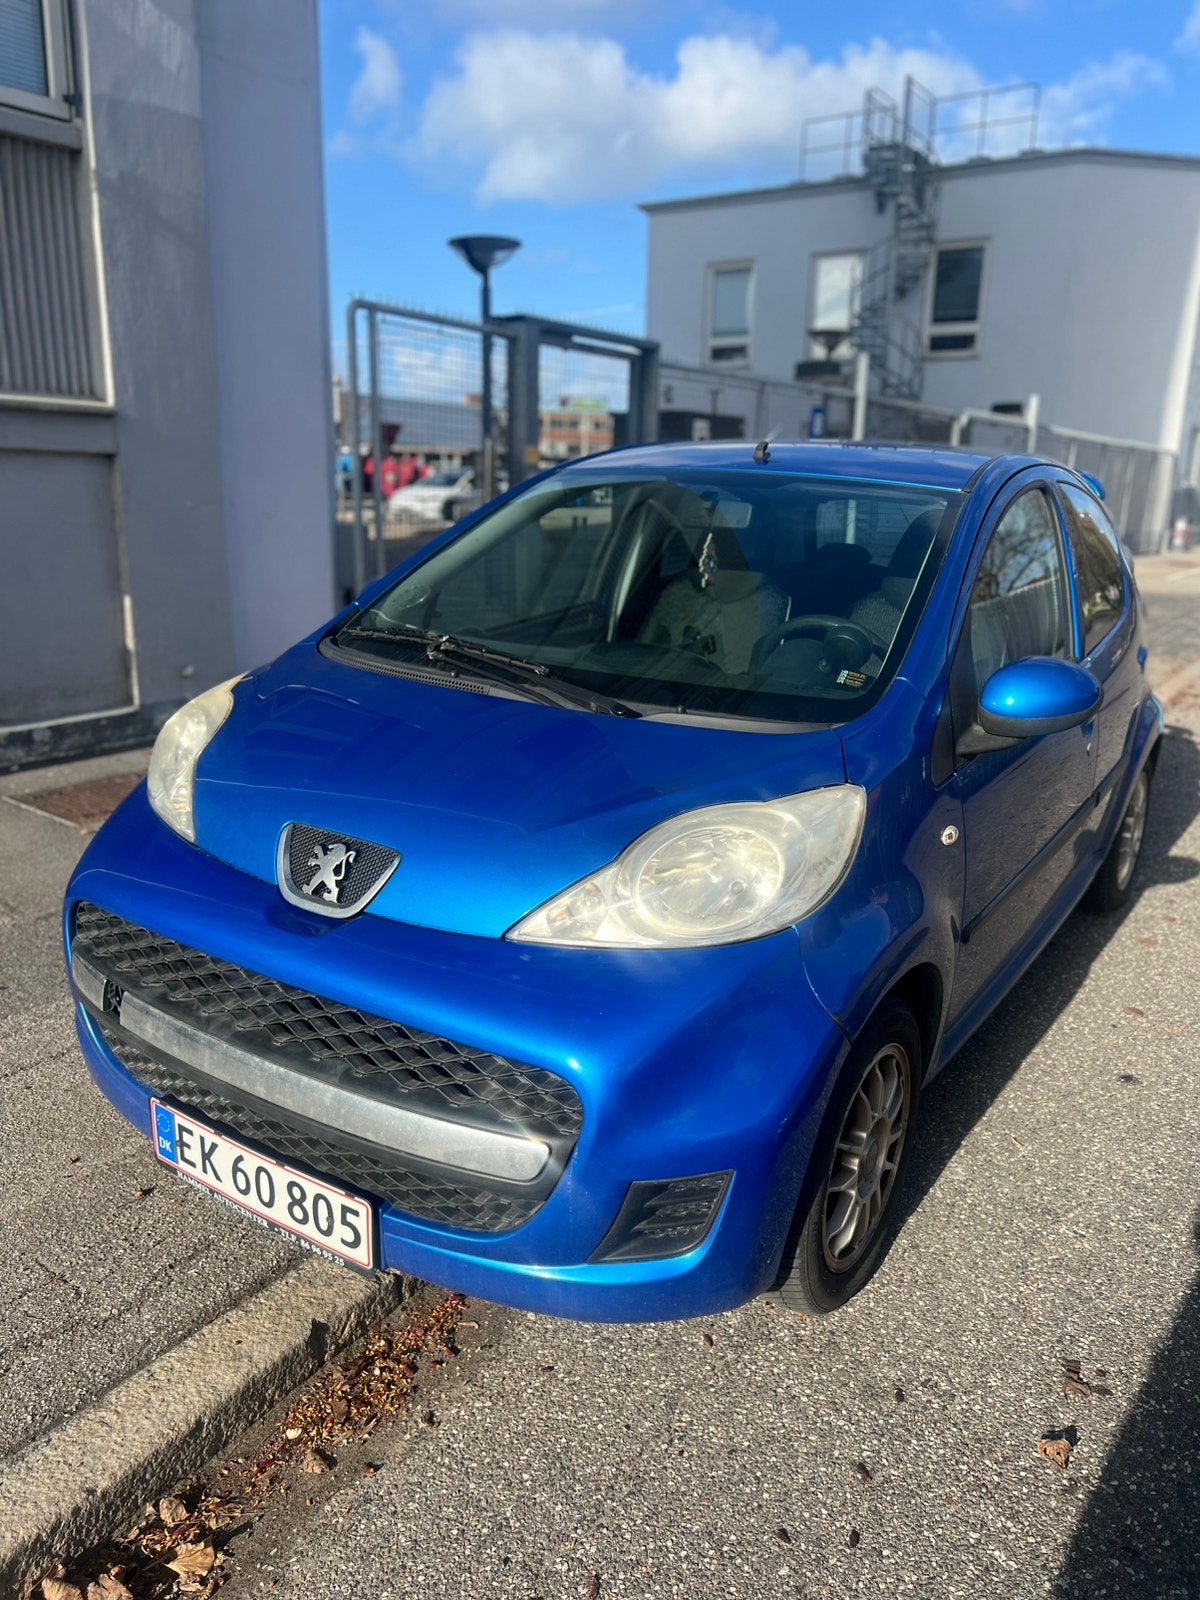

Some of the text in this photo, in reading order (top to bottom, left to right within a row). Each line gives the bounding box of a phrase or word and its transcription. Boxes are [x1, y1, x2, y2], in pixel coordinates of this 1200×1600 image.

[159, 1136, 173, 1153] DK
[177, 1123, 362, 1249] EK 60 805
[213, 1192, 270, 1229] AUTOCENTER
[311, 1244, 322, 1255] 96
[322, 1250, 333, 1261] 95
[334, 1255, 345, 1267] 25
